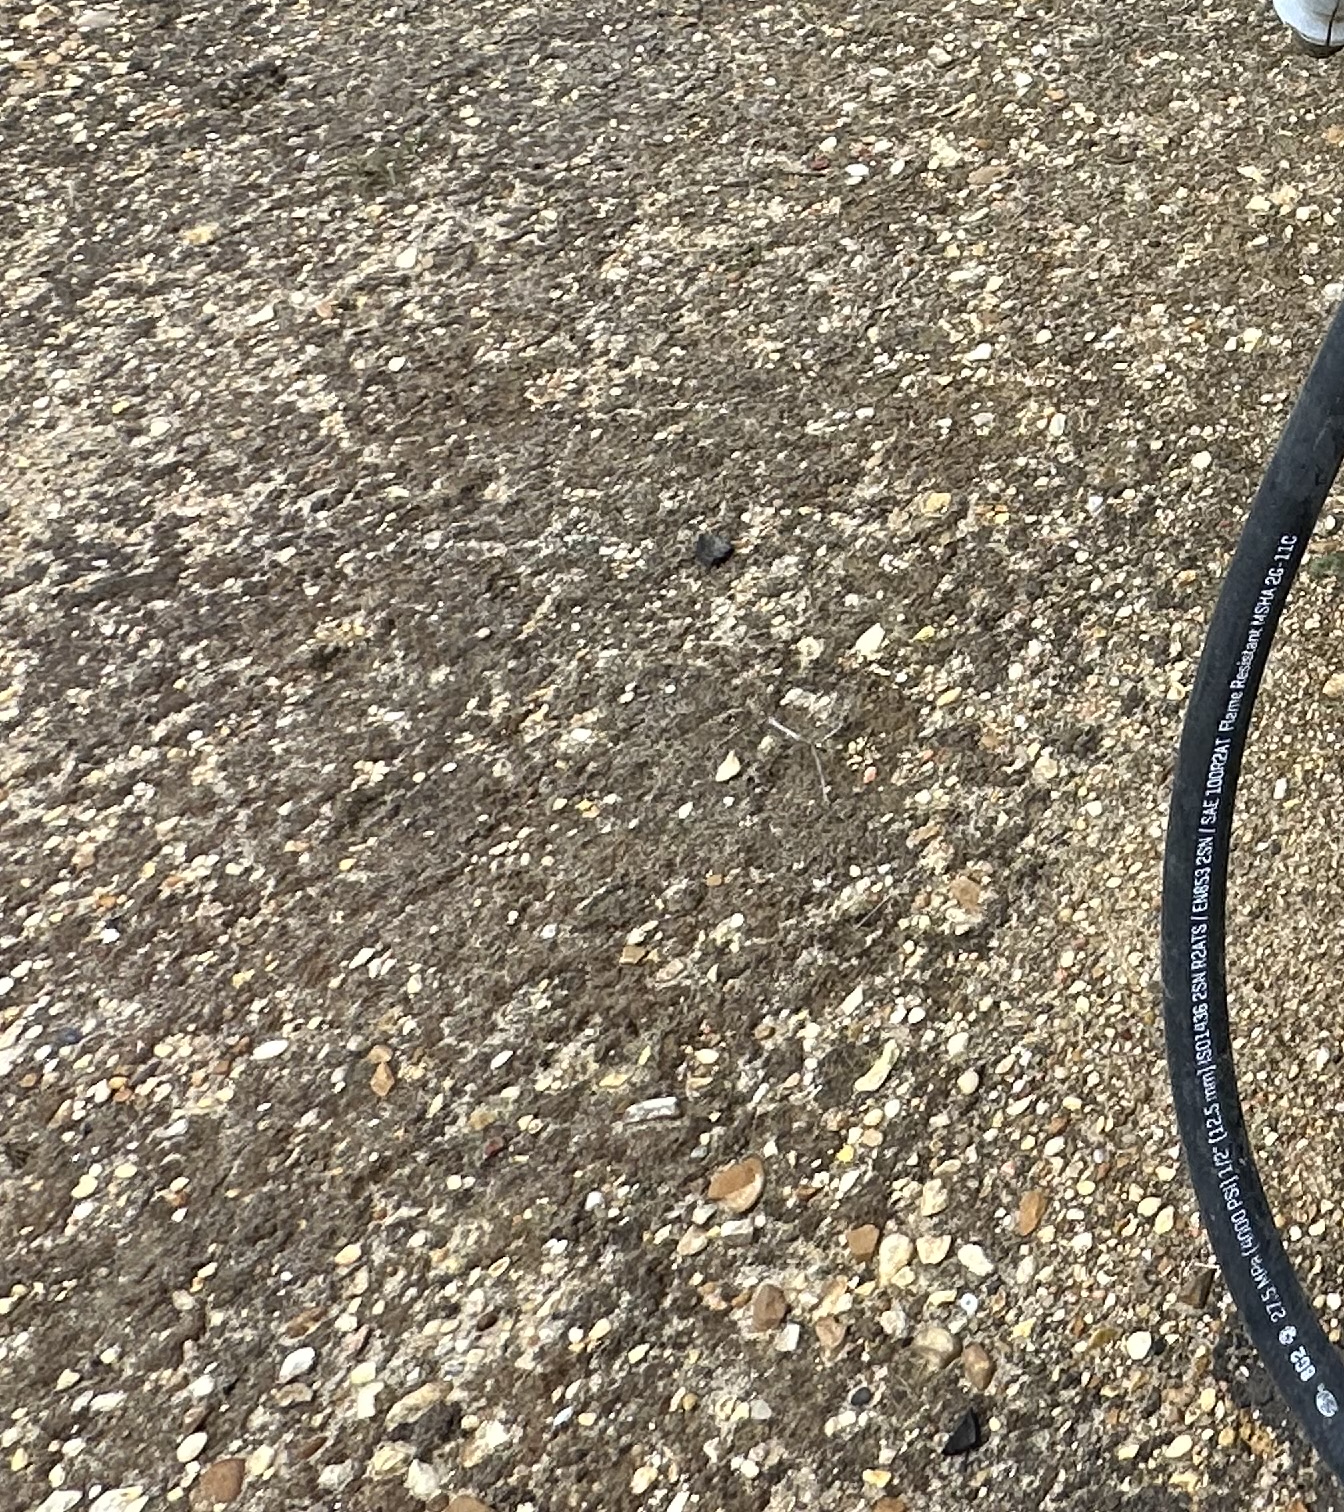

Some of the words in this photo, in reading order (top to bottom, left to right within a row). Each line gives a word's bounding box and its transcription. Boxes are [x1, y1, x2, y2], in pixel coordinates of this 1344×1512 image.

[1264, 534, 1298, 586] 2G-11C
[1249, 587, 1277, 626] MSHA
[1229, 627, 1264, 689] Resistant
[1218, 691, 1244, 732] Flame
[1204, 737, 1232, 798] 100R2AT
[1200, 797, 1220, 826] SAE
[1195, 836, 1214, 866] 2SN
[1191, 866, 1212, 913] EN853
[1190, 923, 1208, 971] R2ATS
[1191, 970, 1208, 1002] 2SN
[1251, 1255, 1270, 1290] MPa
[1261, 1286, 1287, 1323] 27.5
